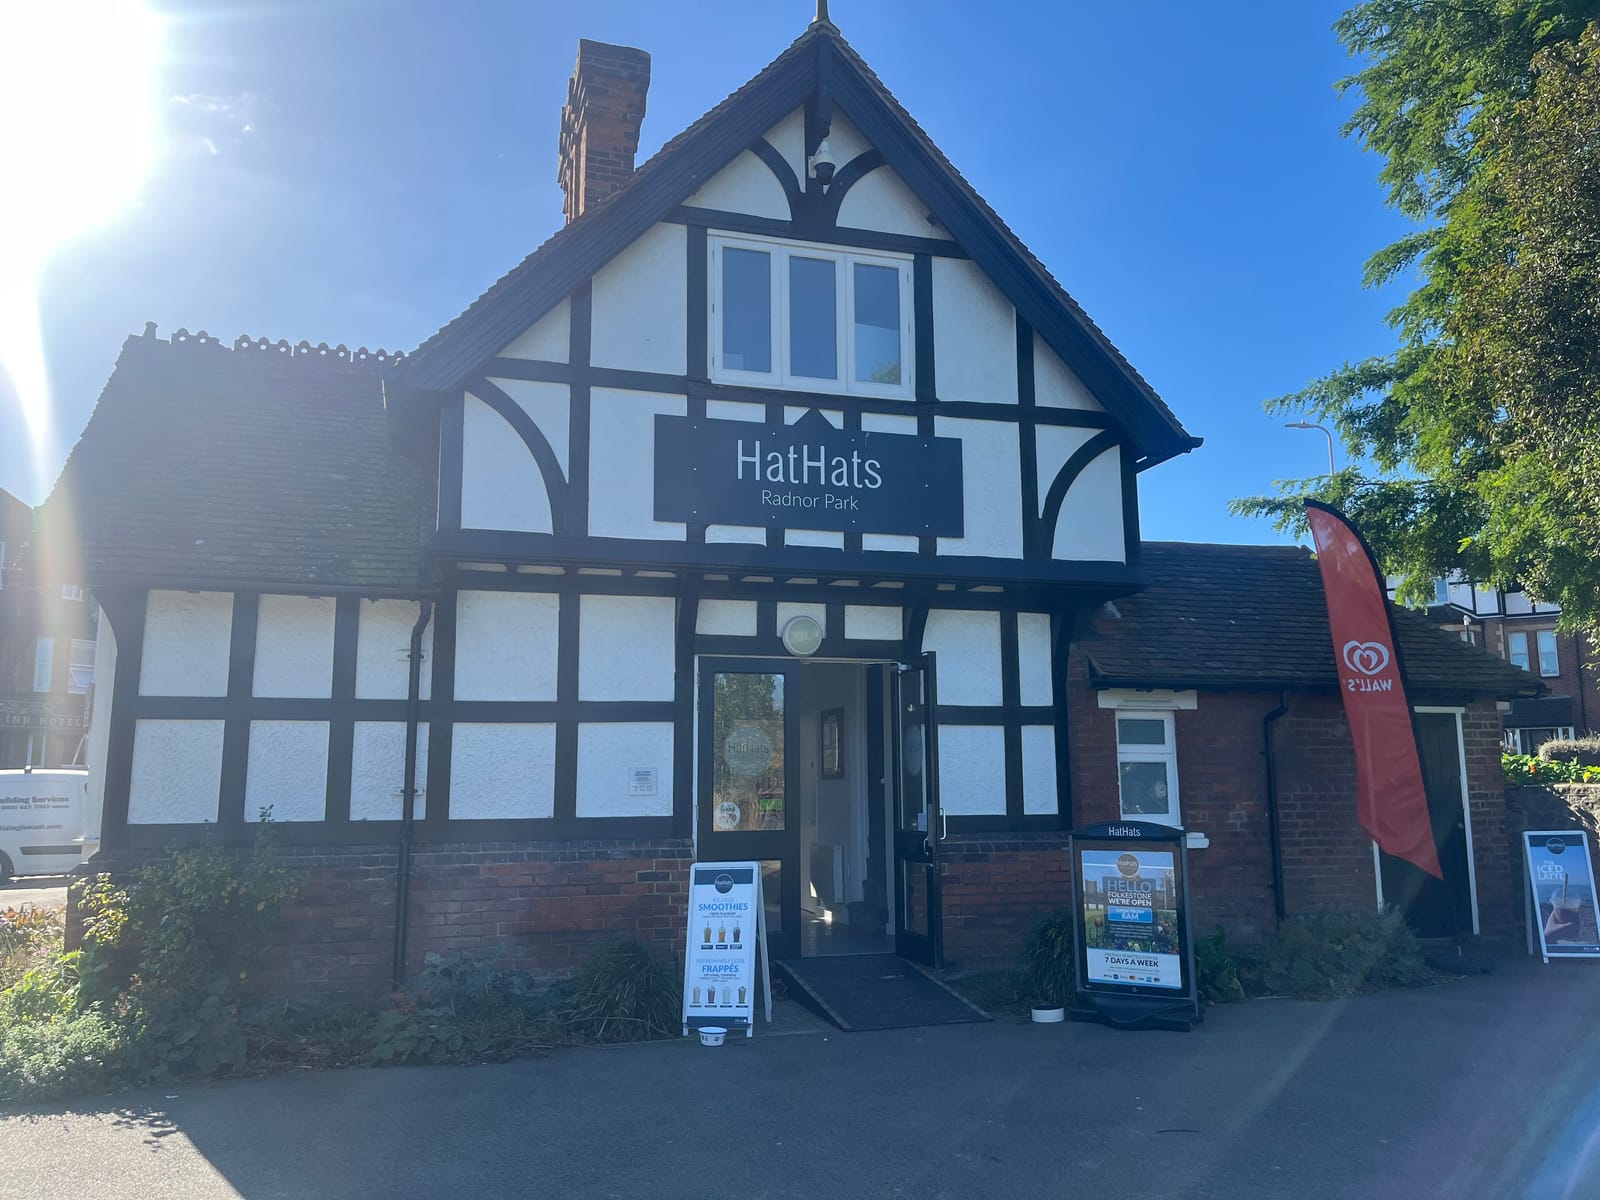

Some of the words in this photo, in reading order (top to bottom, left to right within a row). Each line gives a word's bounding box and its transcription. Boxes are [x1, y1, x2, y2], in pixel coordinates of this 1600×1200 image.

[737, 439, 882, 489] HatHats
[761, 489, 820, 509] Radnor
[824, 493, 859, 511] Park
[40, 717, 81, 727] HOTEL
[1108, 826, 1141, 837] HatHats
[1537, 864, 1564, 873] ICED
[1107, 880, 1152, 893] HELLO
[1107, 891, 1153, 900] FOLKESTONE
[698, 902, 749, 912] SMOOTHIES
[1131, 899, 1152, 907] OPEN
[1111, 957, 1129, 965] DAYS
[1137, 959, 1159, 967] WEEK
